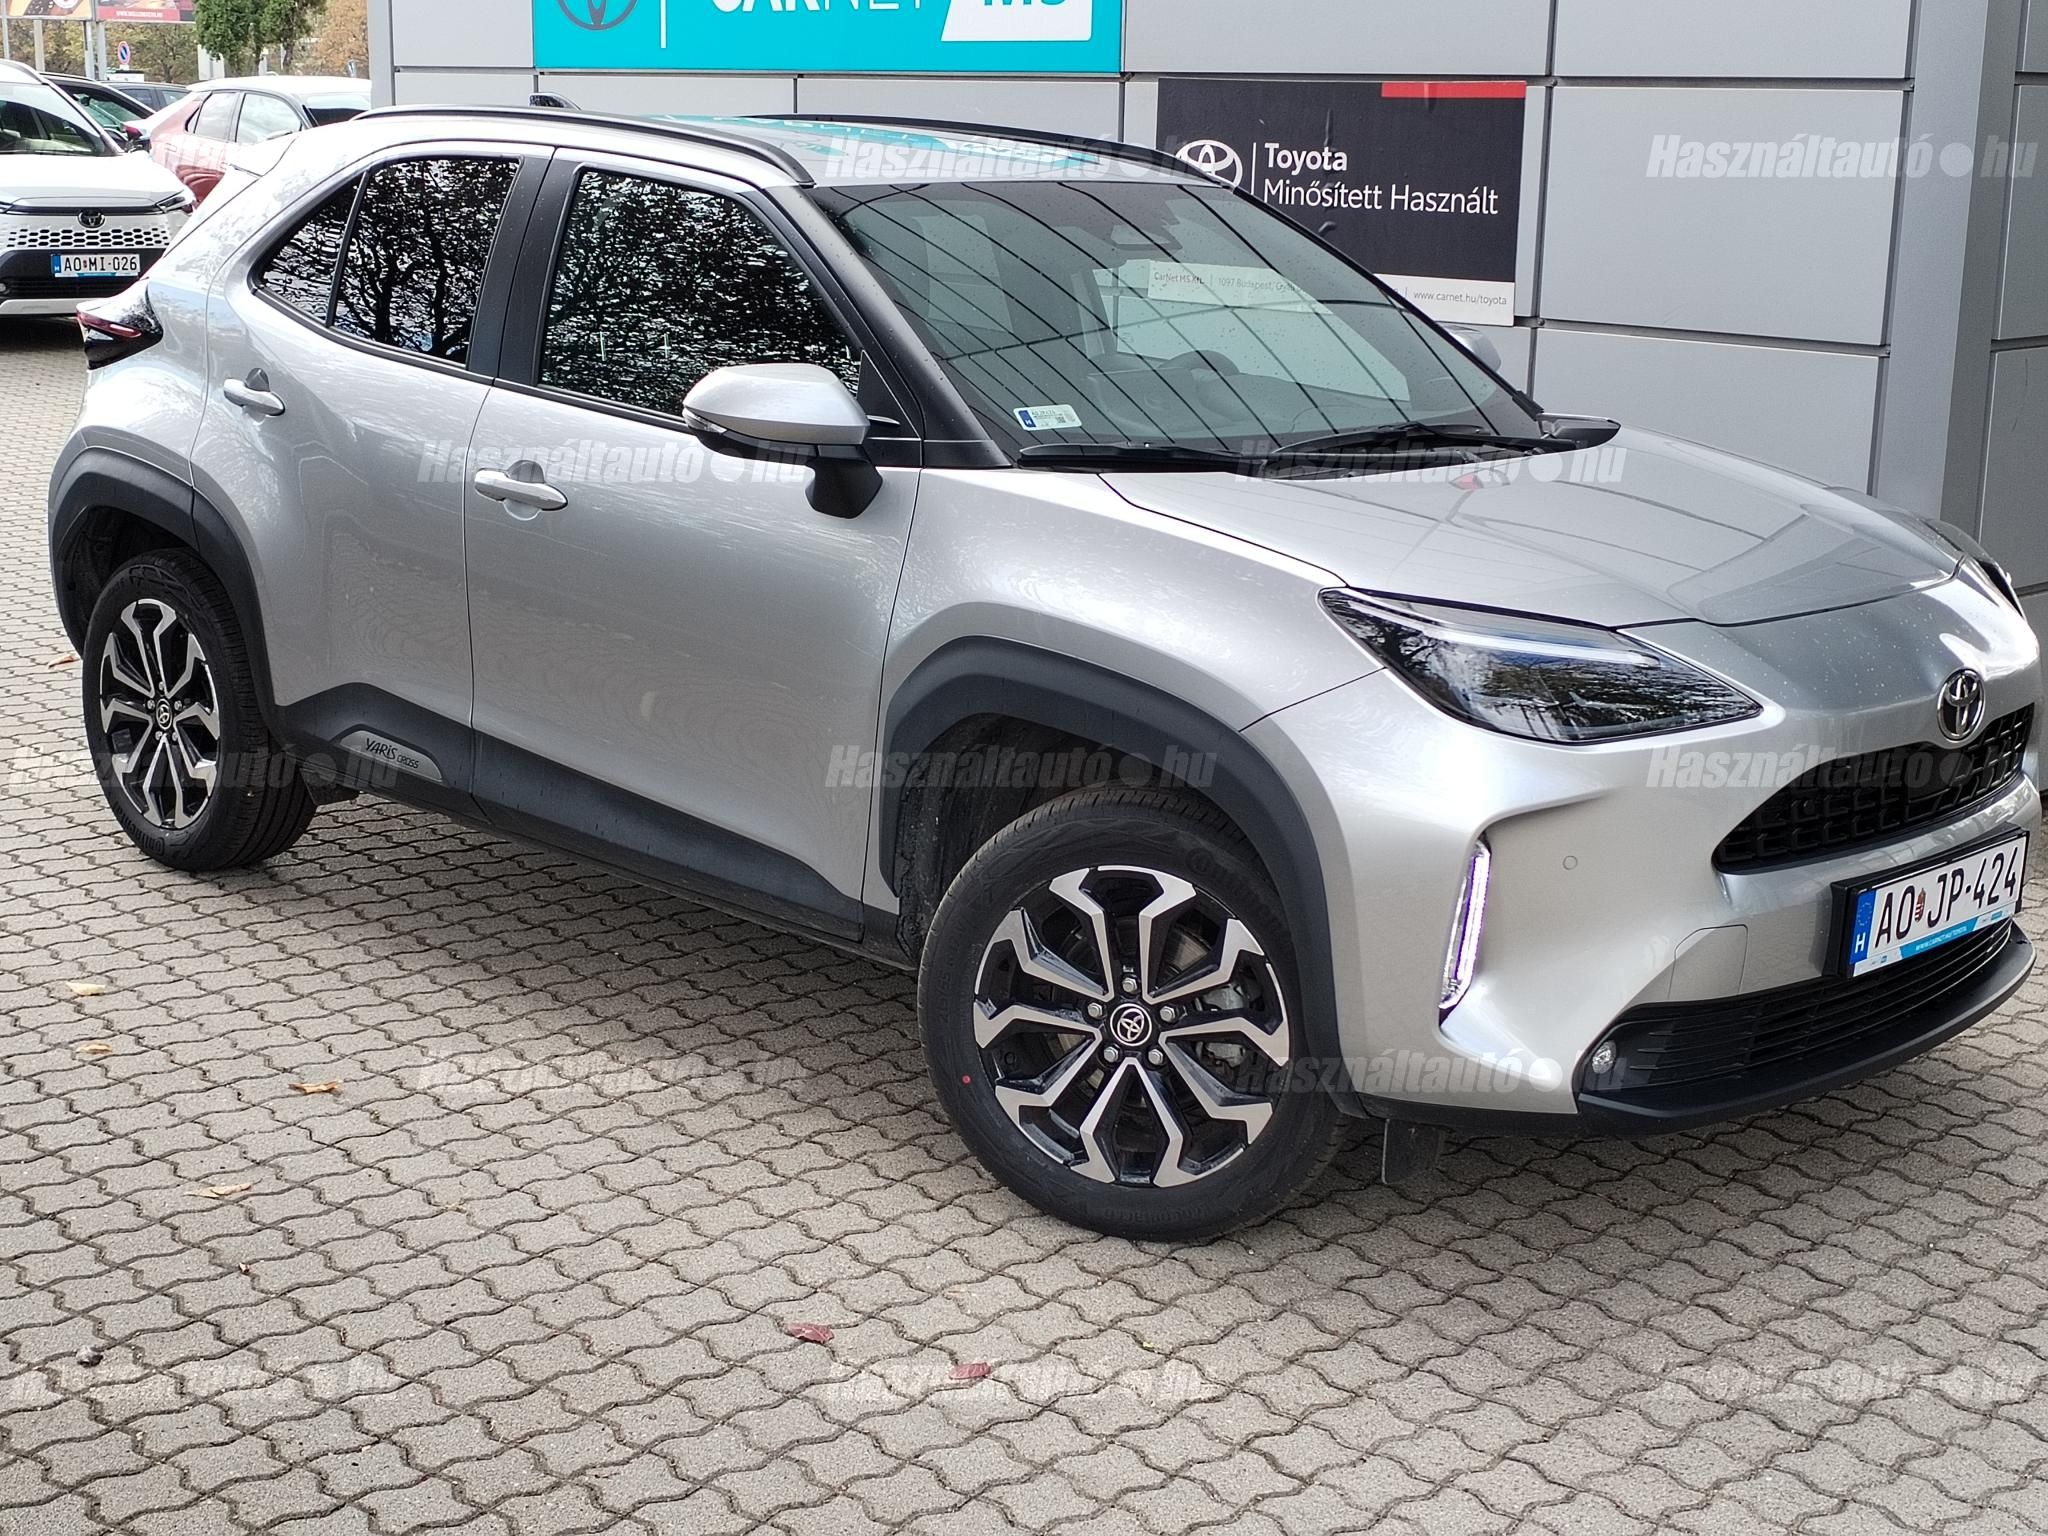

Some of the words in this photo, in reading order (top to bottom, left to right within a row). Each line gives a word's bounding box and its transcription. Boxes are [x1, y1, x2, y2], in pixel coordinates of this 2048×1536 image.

[1264, 142, 1348, 175] Toyota
[1264, 178, 1382, 210] Minősített
[1390, 183, 1499, 214] Használt
[1218, 277, 1235, 288] 1097
[1413, 290, 1507, 307] www.carnet.hu/toyota
